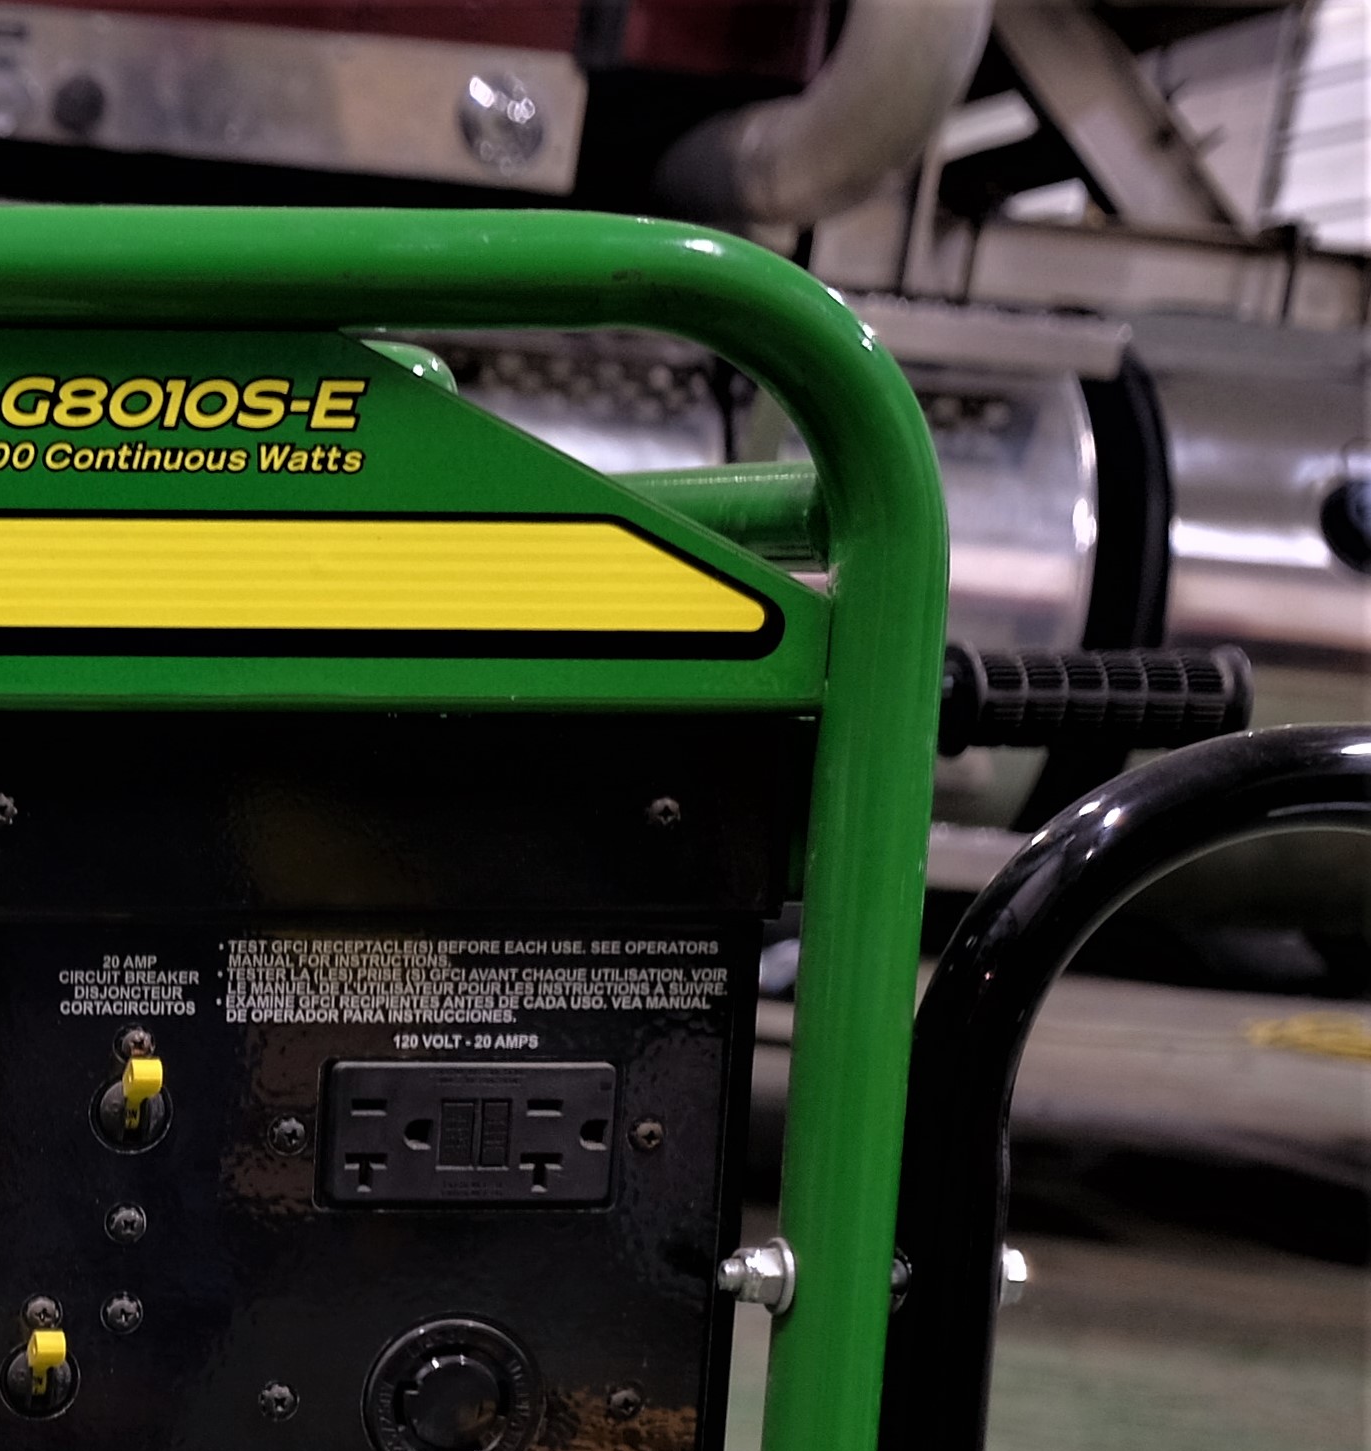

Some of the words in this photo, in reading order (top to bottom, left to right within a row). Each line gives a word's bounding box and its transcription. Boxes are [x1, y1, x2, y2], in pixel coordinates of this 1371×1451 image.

[43, 442, 249, 473] Continuous
[256, 445, 364, 474] Watts
[228, 940, 268, 954] TEST
[270, 940, 308, 954] GFCI
[436, 940, 500, 954] BEFORE
[504, 940, 548, 954] EACH
[591, 940, 621, 954] SEE
[102, 955, 120, 969] 20
[122, 955, 158, 969] AMP
[228, 954, 295, 967] MANUAL
[298, 954, 331, 967] FOR
[58, 970, 121, 985] CIRCUIT
[124, 970, 200, 985] BREAKER
[226, 968, 287, 982] TESTER
[290, 968, 311, 982] LA
[313, 968, 354, 983] (LES)
[429, 968, 466, 982] GFCI
[468, 968, 519, 982] AVANT
[521, 968, 587, 982] CHAQUE
[691, 968, 728, 982] VOIR
[74, 985, 183, 1000] DISJONCTEUR
[226, 982, 247, 996] LE
[250, 982, 315, 996] MANUEL
[318, 982, 340, 996] DE
[343, 982, 454, 996] L'UTILISATEUR
[457, 982, 502, 996] POUR
[505, 982, 535, 996] LES
[537, 982, 650, 996] INSTRUCTIONS
[59, 1000, 196, 1016] CORTACIRCUITOS
[225, 996, 295, 1010] EXAMINE
[298, 996, 338, 1010] GFCI
[339, 996, 441, 1010] RECIPIENTES
[443, 996, 494, 1010] ANTES
[497, 996, 522, 1010] DE
[523, 996, 567, 1010] CADA
[611, 996, 643, 1010] VEA
[645, 996, 710, 1010] MANUAL
[226, 1010, 248, 1023] DE
[251, 1010, 339, 1023] OPERADOR
[343, 1010, 385, 1023] PARA
[393, 1034, 419, 1049] 120
[422, 1034, 463, 1049] VOLT
[474, 1034, 492, 1049] 20
[494, 1034, 539, 1049] AMPS
